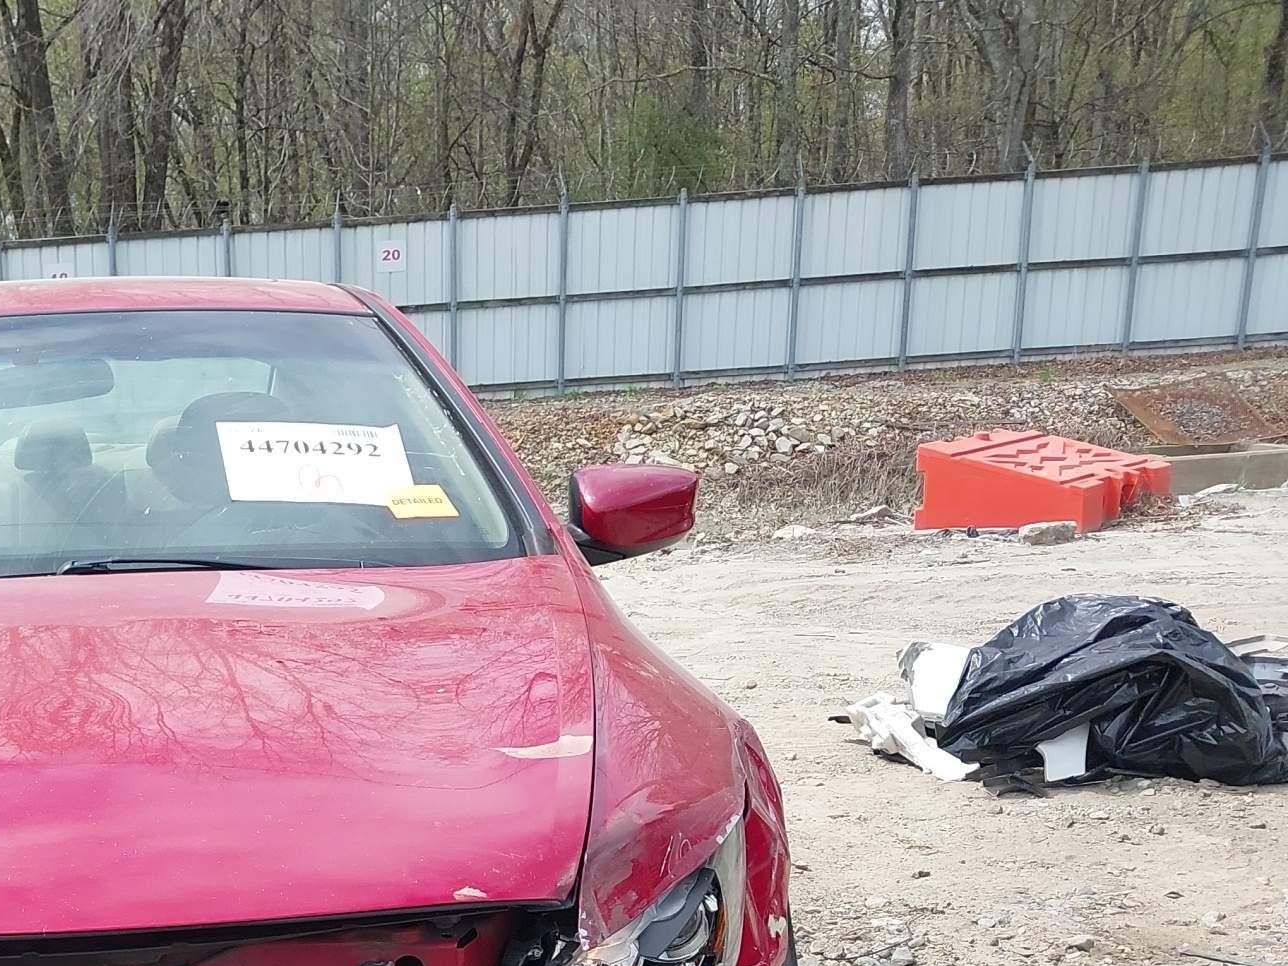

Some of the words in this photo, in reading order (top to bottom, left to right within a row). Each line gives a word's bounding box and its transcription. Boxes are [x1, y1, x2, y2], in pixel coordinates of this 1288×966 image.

[382, 249, 401, 261] 20
[240, 439, 381, 457] 44704292
[392, 497, 443, 505] DETAILED
